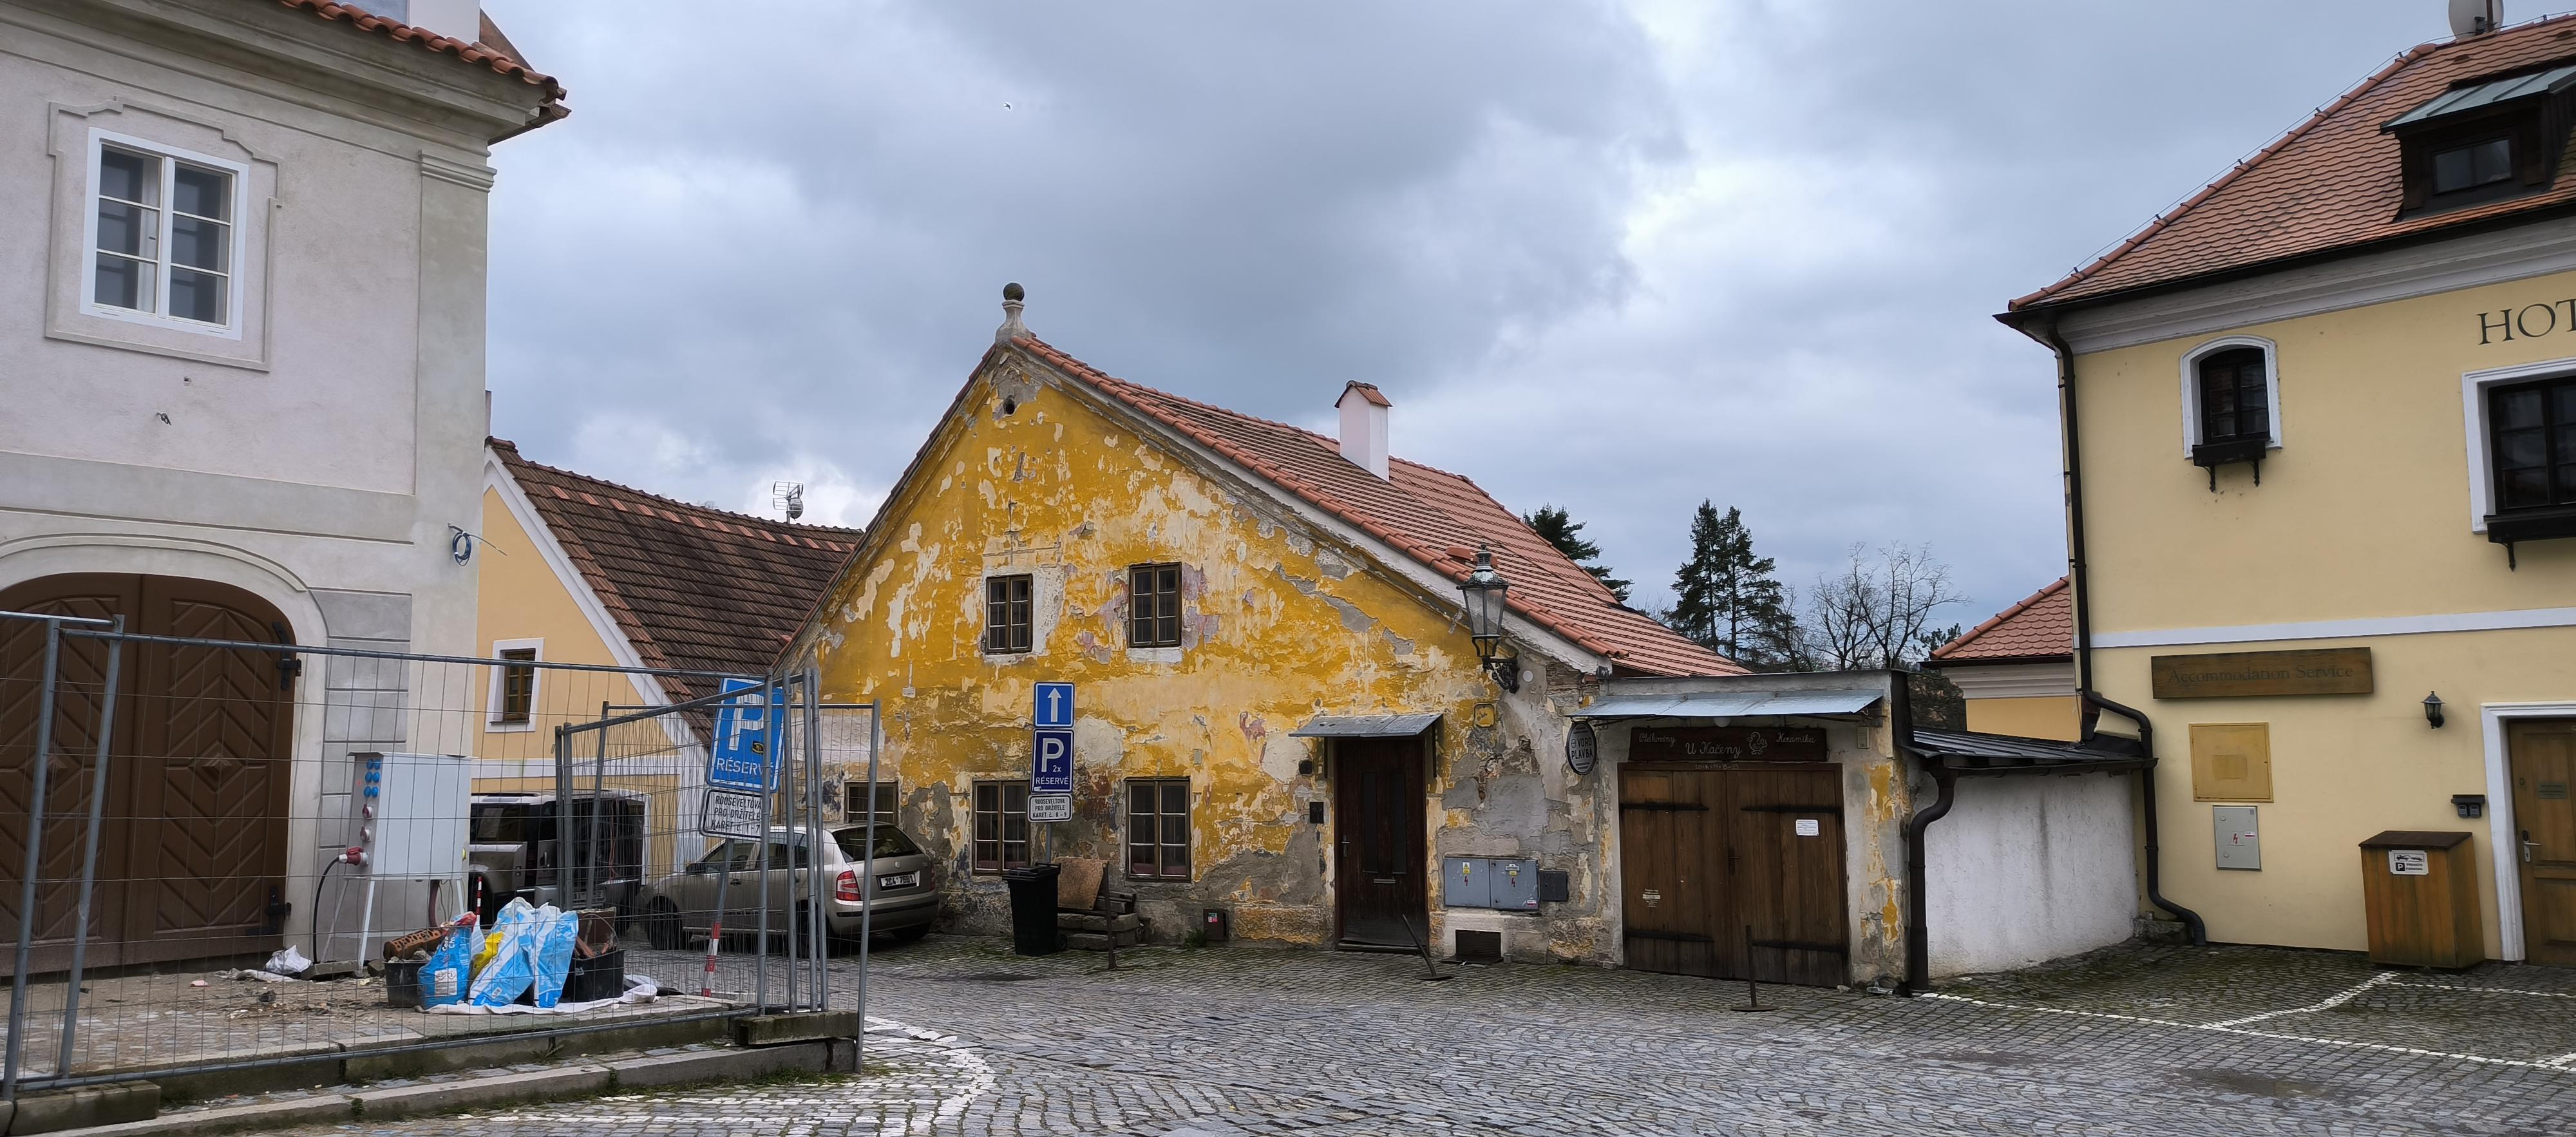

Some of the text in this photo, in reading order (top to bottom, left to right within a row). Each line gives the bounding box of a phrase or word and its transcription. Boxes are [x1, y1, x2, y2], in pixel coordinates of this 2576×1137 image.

[2168, 664, 2353, 683] Accommodation Service
[728, 692, 766, 751] P
[1577, 738, 1592, 747] VORO
[1776, 732, 1816, 743] Keramika
[1041, 738, 1065, 772] P
[1571, 749, 1593, 760] PLAVBA
[1685, 741, 1743, 759] U Kačeny
[1036, 775, 1069, 785] RÉSERVÉ
[715, 795, 761, 810] ROOSEVELTOVA
[714, 807, 761, 821] PRO DRŽITELE
